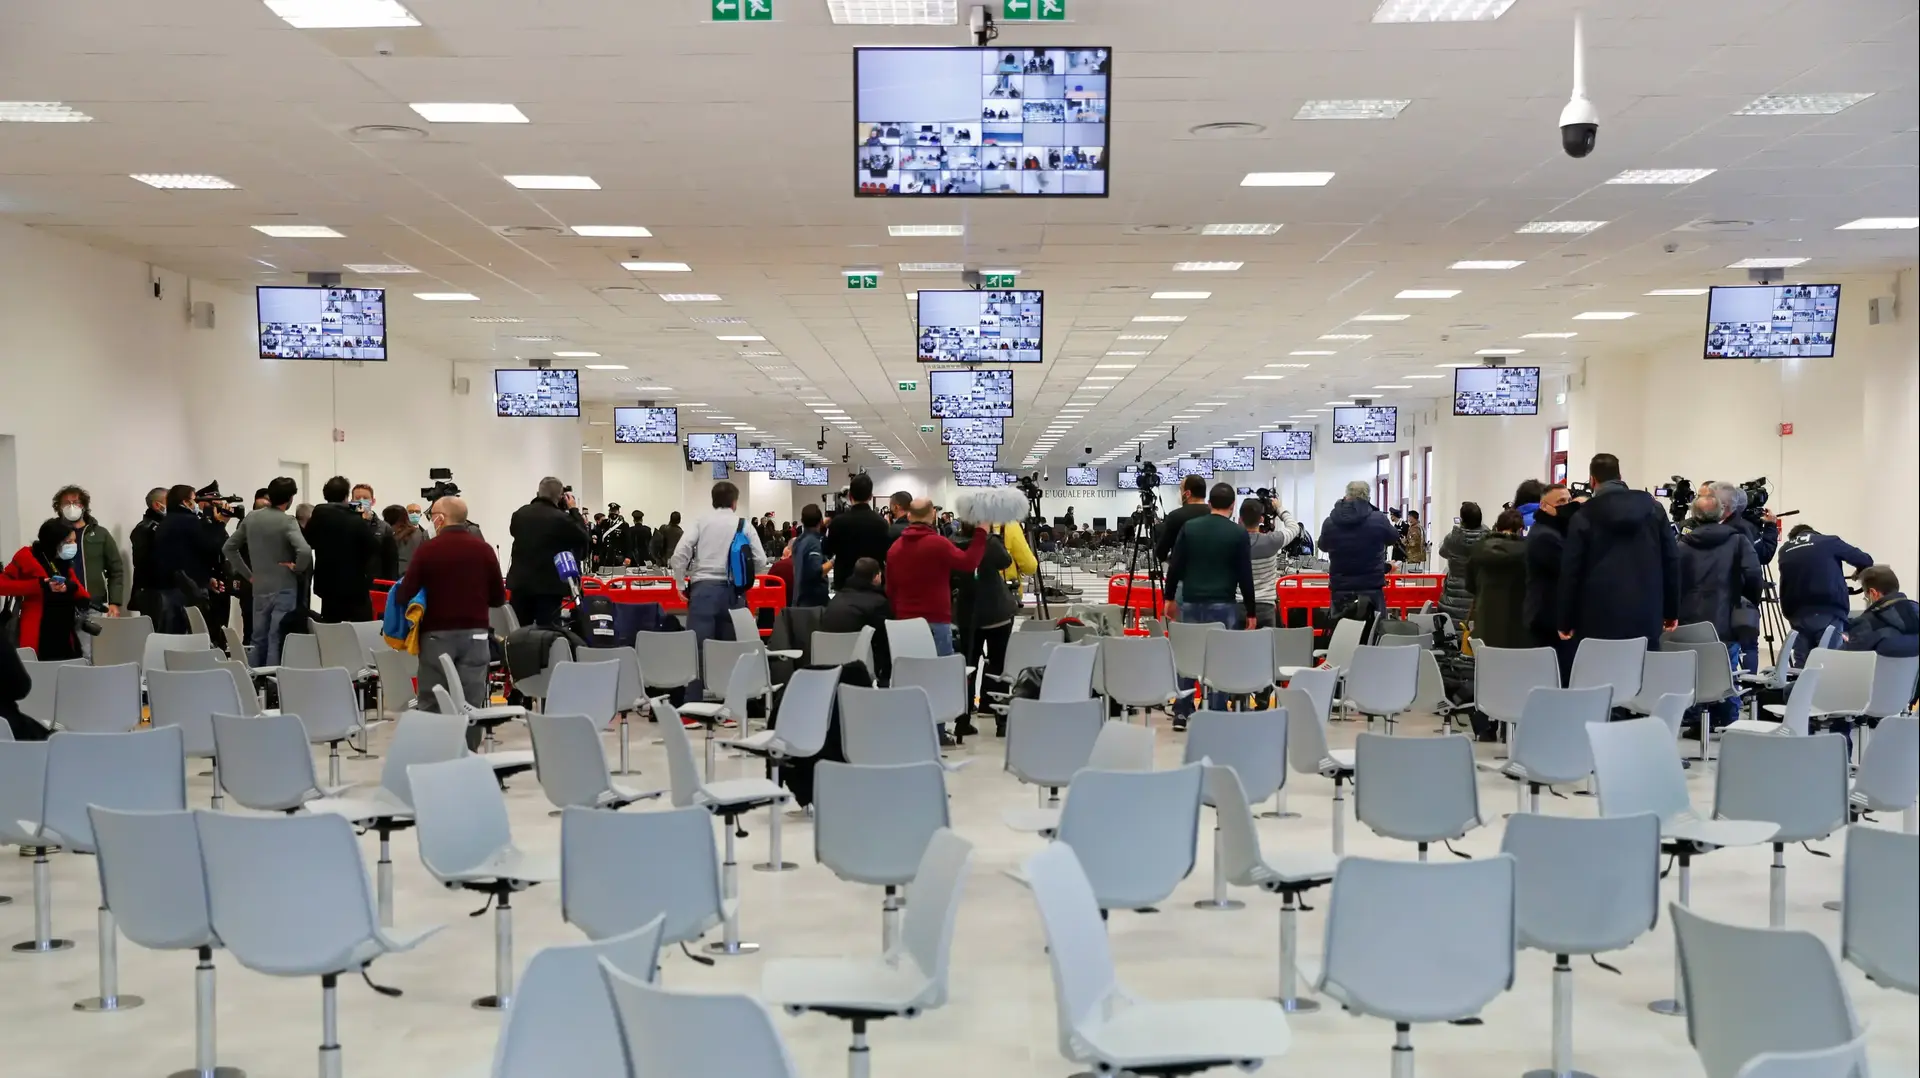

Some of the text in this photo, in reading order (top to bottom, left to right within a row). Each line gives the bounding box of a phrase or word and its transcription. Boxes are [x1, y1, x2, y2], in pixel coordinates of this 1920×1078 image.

[1052, 489, 1080, 498] UGUALE
[1082, 489, 1096, 498] PER
[1097, 489, 1117, 498] TUTTI
